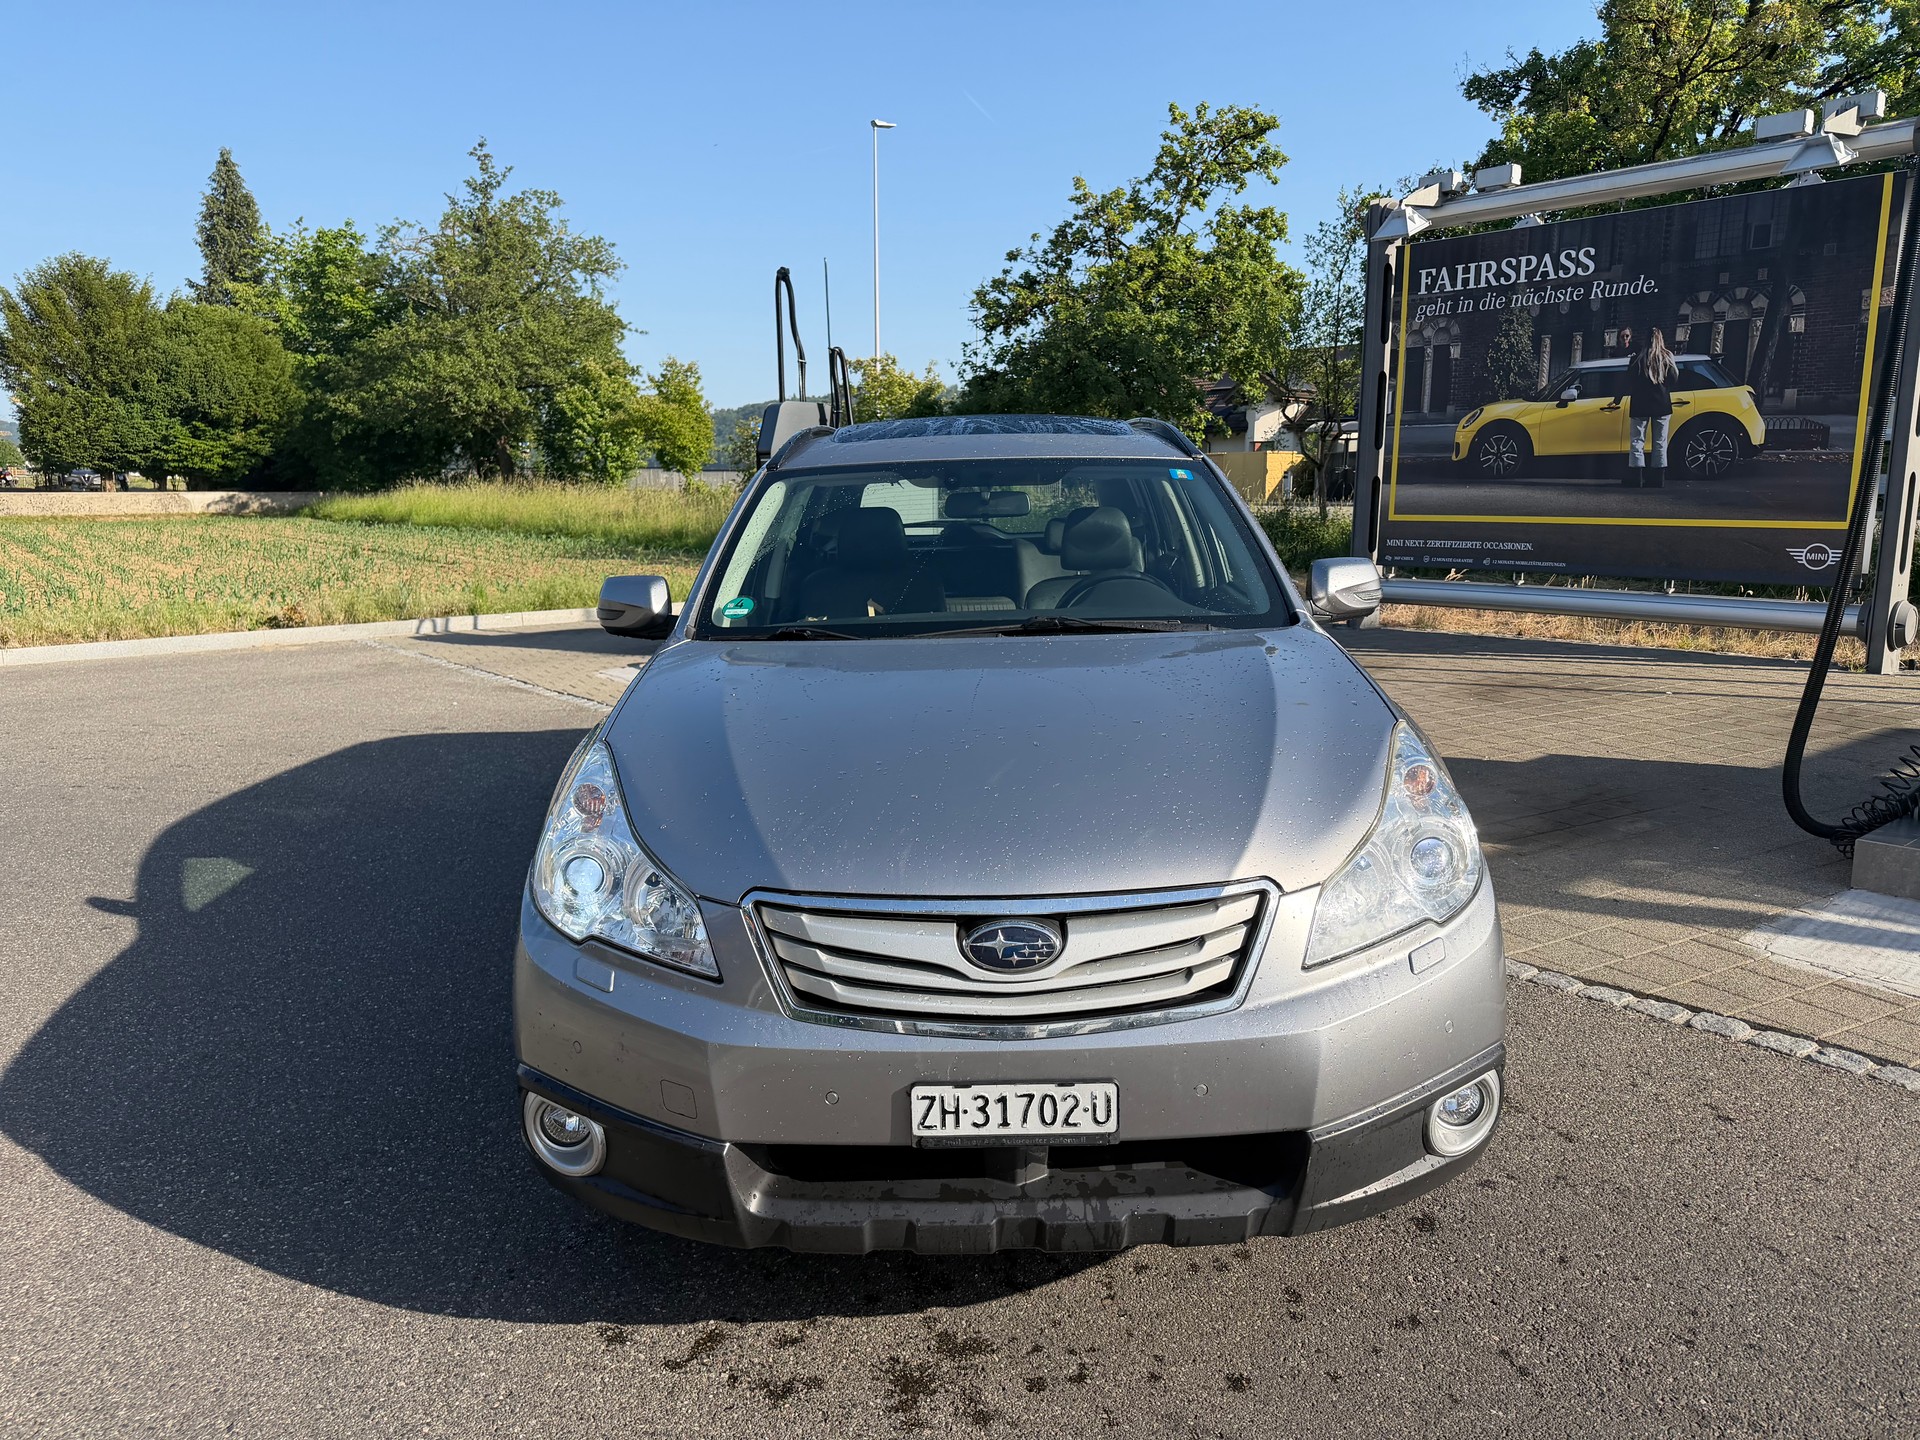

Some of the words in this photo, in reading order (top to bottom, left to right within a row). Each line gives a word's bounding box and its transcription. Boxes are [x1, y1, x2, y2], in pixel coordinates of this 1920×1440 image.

[1417, 247, 1596, 295] FAHRSPASS
[1415, 296, 1453, 322] geht
[1457, 296, 1473, 313] in
[1479, 292, 1505, 311] die
[1511, 286, 1584, 307] nächste
[1589, 275, 1659, 299] Runde.
[1386, 539, 1403, 547] MINI
[1404, 539, 1425, 547] NEXT.
[1426, 540, 1482, 549] ZERTIFIZIERTE
[1483, 541, 1534, 551] OCCASIONEN.
[1806, 552, 1828, 561] MINI
[735, 599, 744, 608] 4
